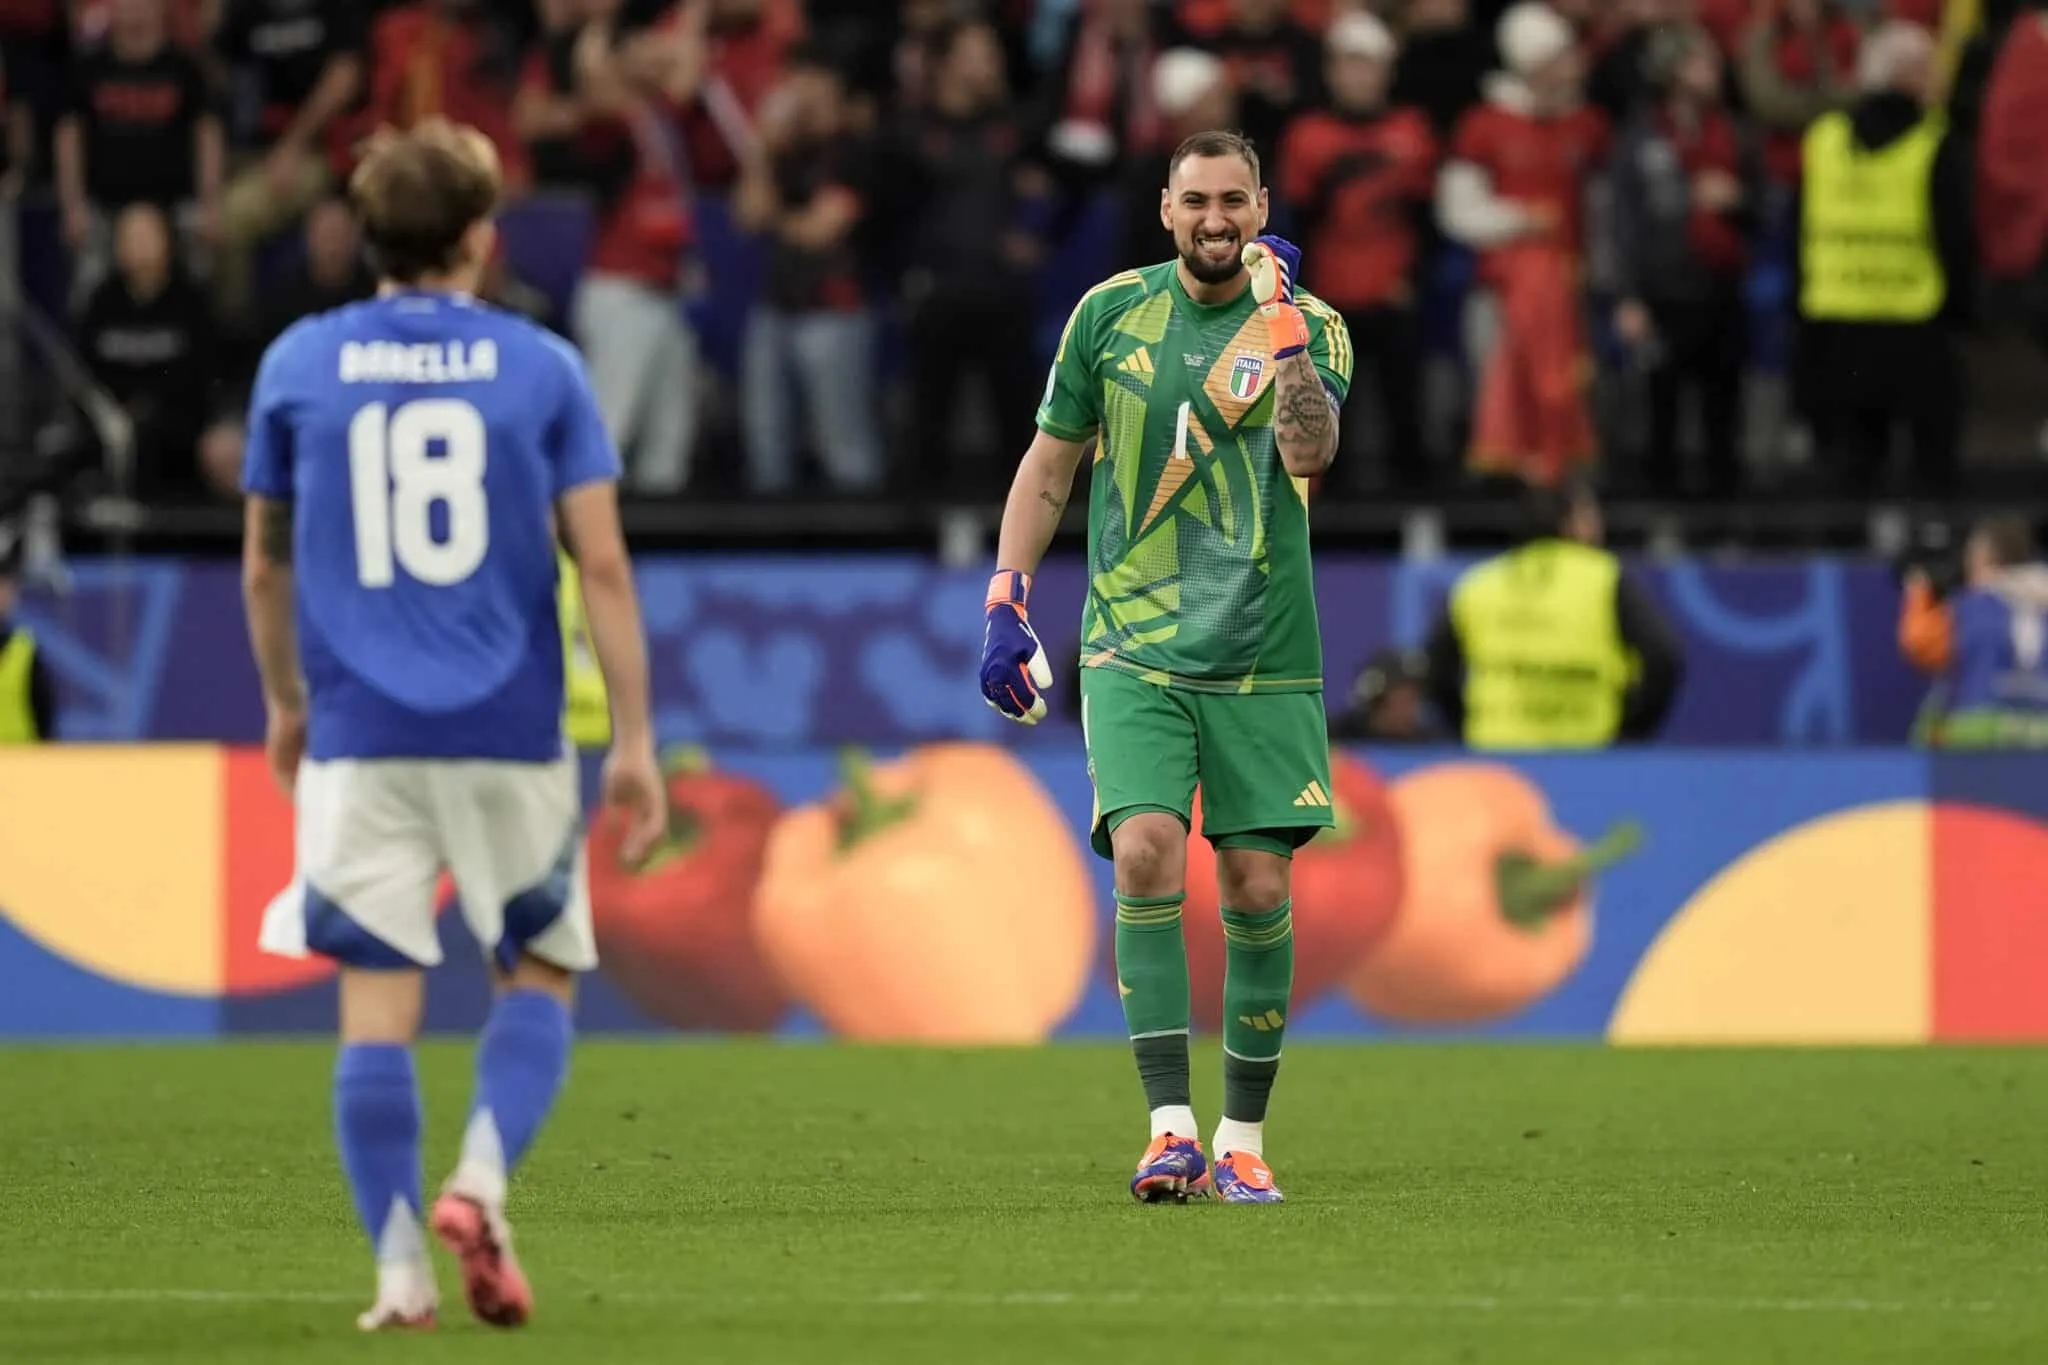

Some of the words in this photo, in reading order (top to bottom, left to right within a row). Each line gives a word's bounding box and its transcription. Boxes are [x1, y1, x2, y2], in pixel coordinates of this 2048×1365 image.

[339, 338, 498, 384] BARELLA
[1236, 359, 1261, 371] ITALIA
[1175, 401, 1190, 460] 1
[348, 397, 489, 588] 18
